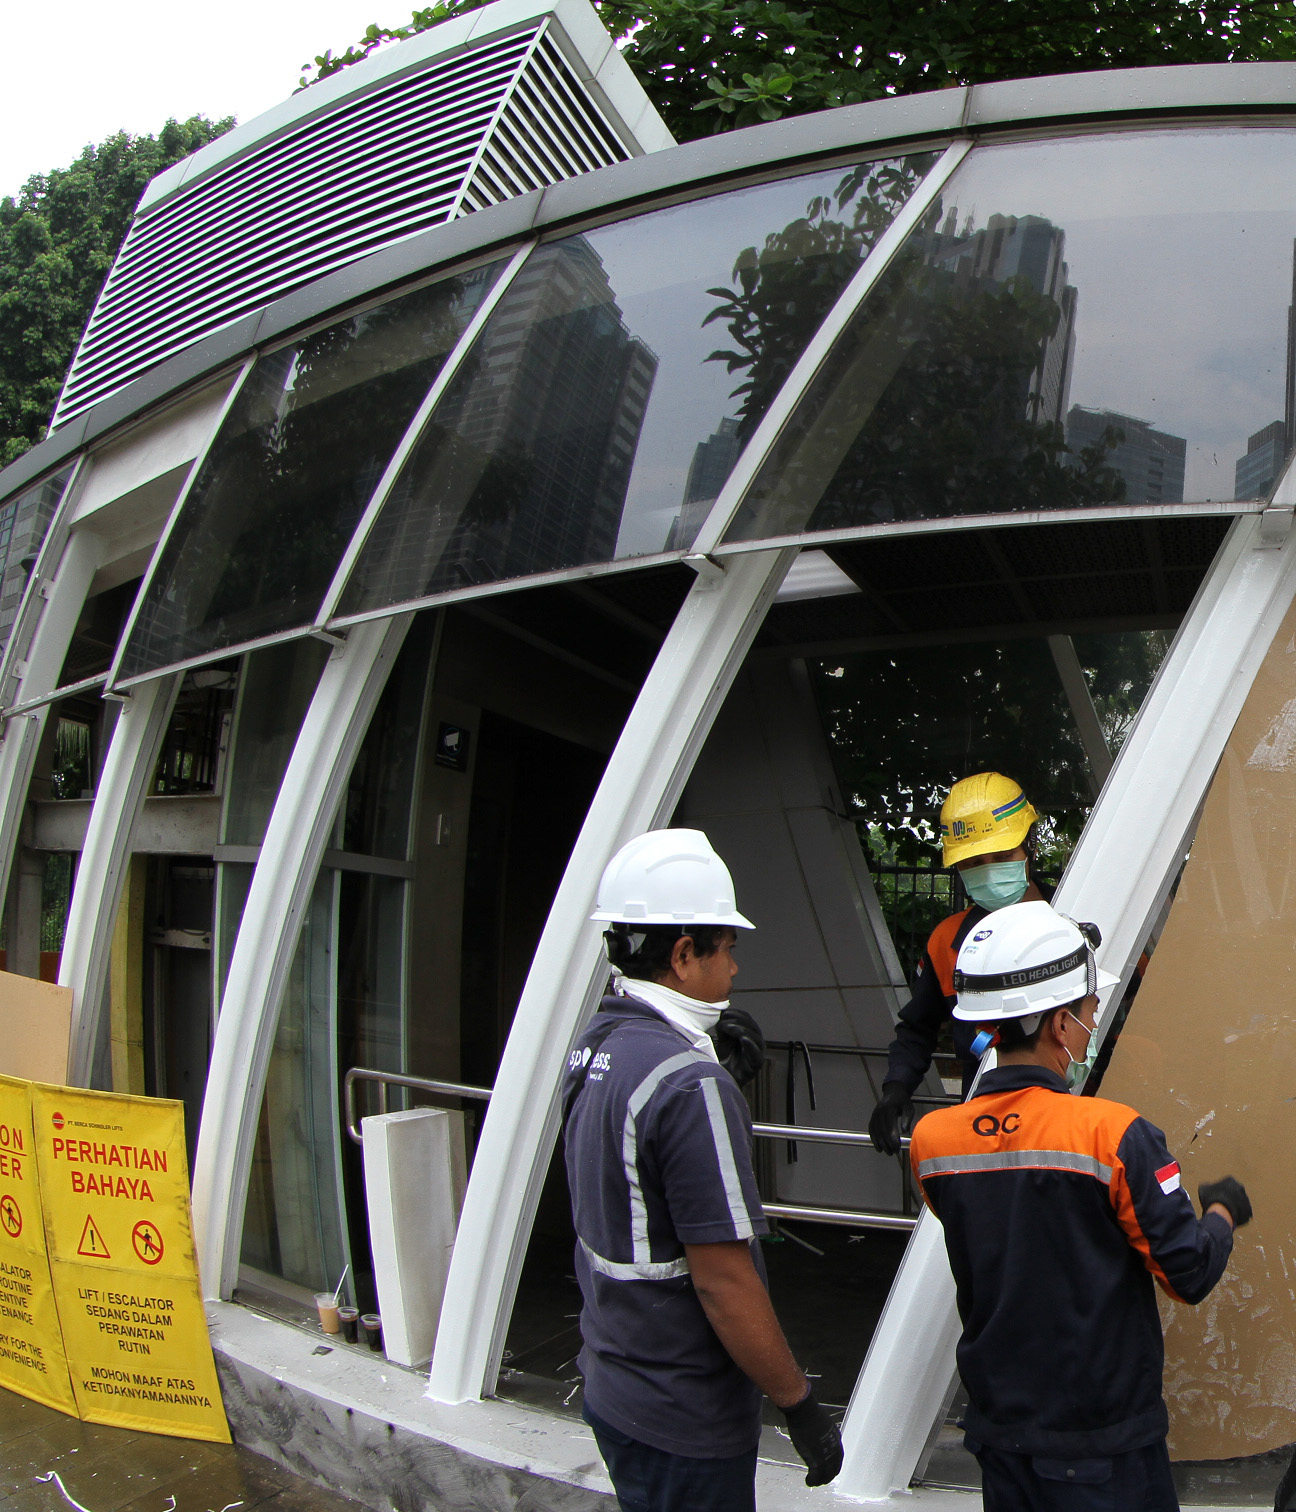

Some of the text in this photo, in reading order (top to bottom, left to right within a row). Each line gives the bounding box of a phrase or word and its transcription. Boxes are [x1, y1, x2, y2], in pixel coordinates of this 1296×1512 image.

[1002, 954, 1080, 987] LED HEADLIGHT
[972, 1113, 1020, 1137] QC
[52, 1137, 168, 1173] PERHATIAN
[71, 1170, 155, 1202] BAHAYA
[78, 1288, 99, 1301] LIFT
[107, 1292, 175, 1311] ESCALATOR
[86, 1304, 173, 1326] SEDANG DALAM
[98, 1321, 165, 1341] PERAWATAN
[10, 1336, 28, 1352] FOR
[27, 1342, 43, 1359] THE
[118, 1339, 151, 1355] RUTIN
[91, 1366, 196, 1391] MOHON MAAF ATAS
[82, 1380, 213, 1409] KETIDAKNYAMANANNYA
